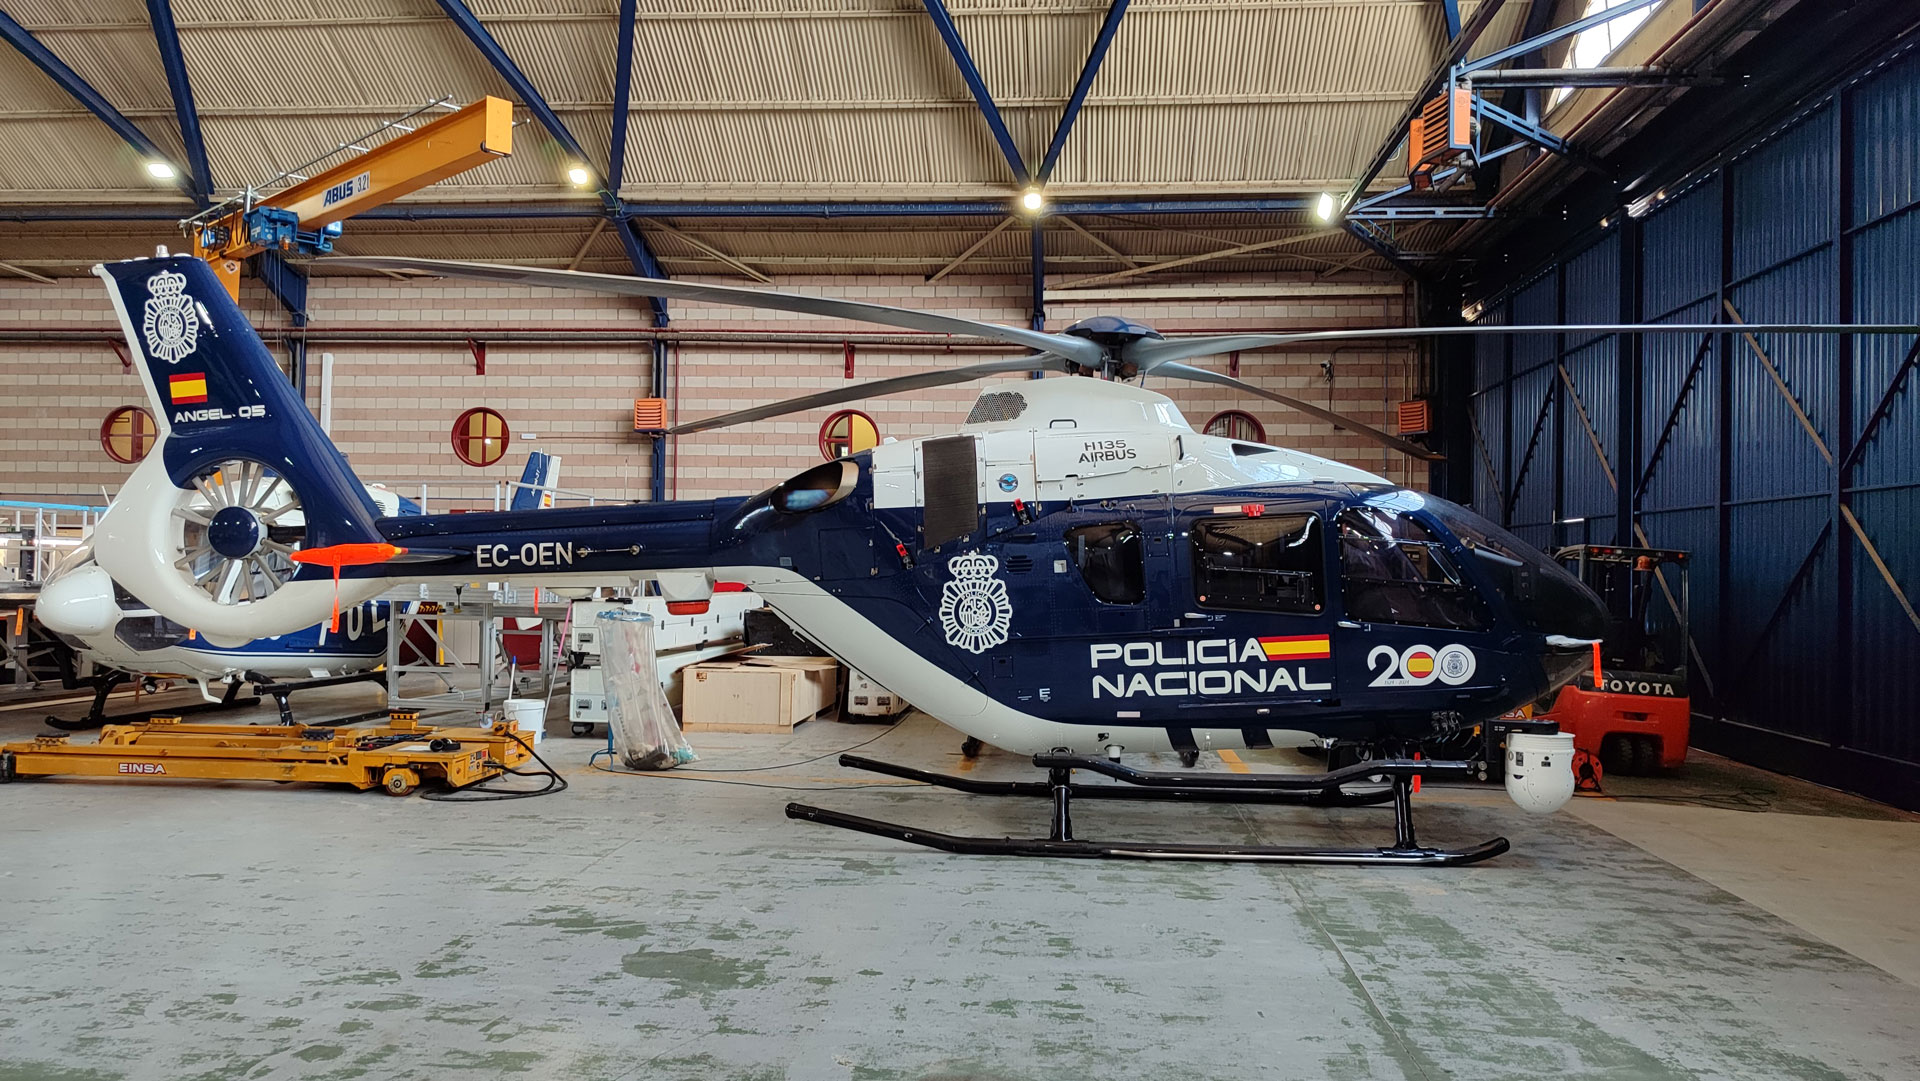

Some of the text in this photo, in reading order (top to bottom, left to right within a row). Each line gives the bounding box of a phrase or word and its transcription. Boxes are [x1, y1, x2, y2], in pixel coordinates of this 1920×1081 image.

[323, 180, 353, 208] ABUS
[174, 404, 266, 423] ANGEL 05
[1084, 439, 1127, 451] H135
[1078, 448, 1137, 464] AIRBUS
[476, 541, 573, 568] EC-OEN
[1092, 666, 1332, 699] NACIONAL
[1600, 679, 1675, 696] TOYOTA
[119, 763, 166, 774] EINSA
